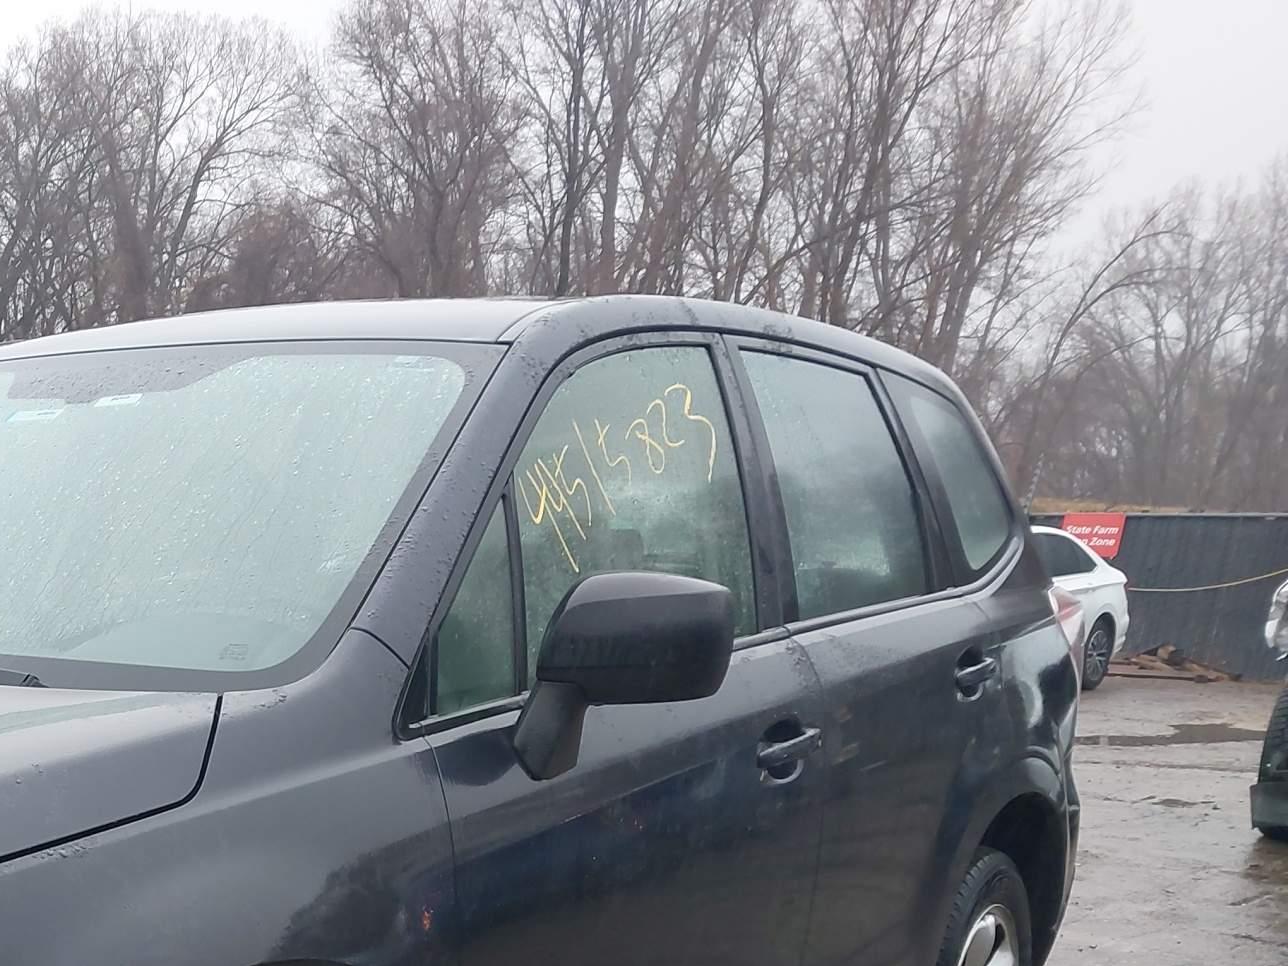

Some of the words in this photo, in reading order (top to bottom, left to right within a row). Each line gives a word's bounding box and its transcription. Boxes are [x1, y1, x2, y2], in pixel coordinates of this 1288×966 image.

[518, 383, 717, 573] 44515823
[1066, 525, 1092, 534] State
[1092, 525, 1119, 534] Farm
[1088, 537, 1116, 546] Zone
